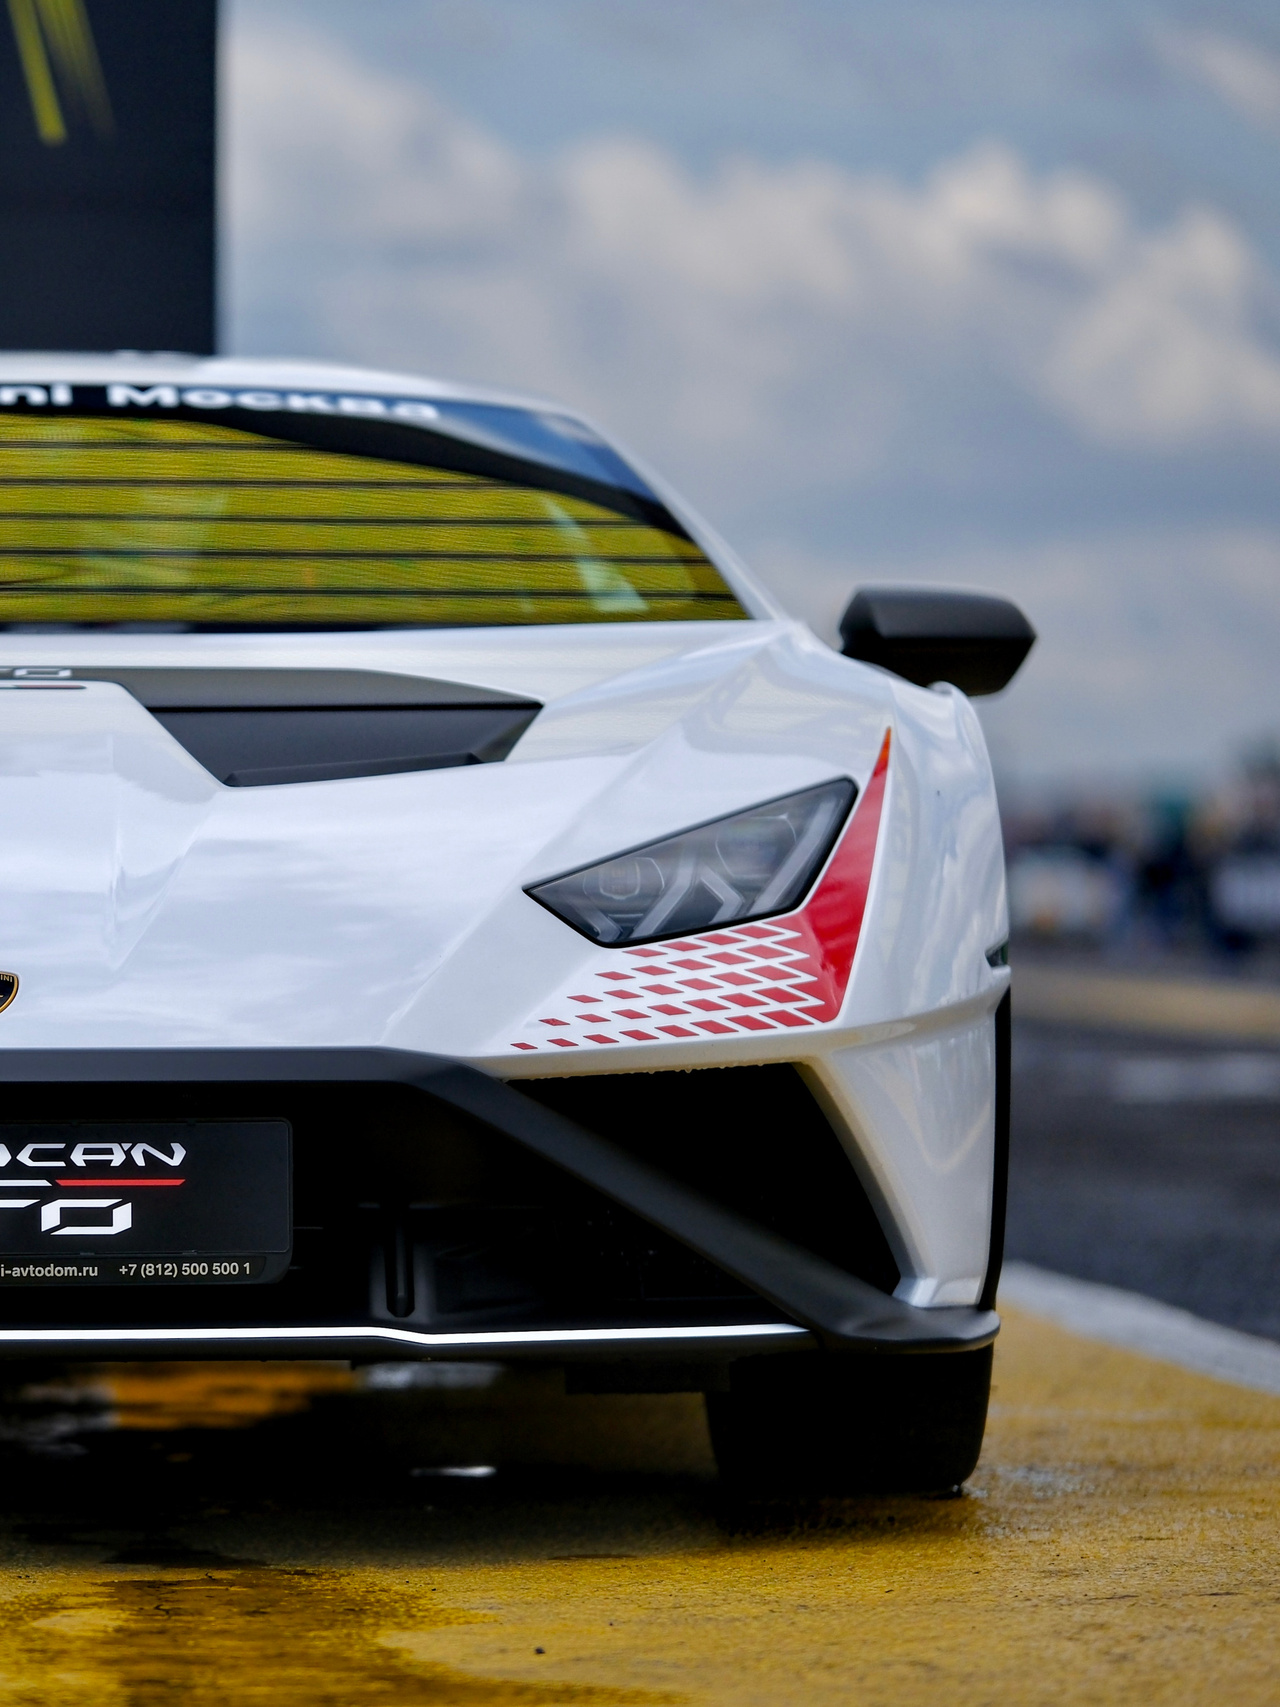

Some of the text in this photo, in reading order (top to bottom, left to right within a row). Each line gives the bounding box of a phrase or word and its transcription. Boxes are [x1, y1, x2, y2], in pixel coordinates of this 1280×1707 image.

[106, 384, 440, 419] Москва
[119, 1262, 251, 1278] +7 (812) 500 500 1
